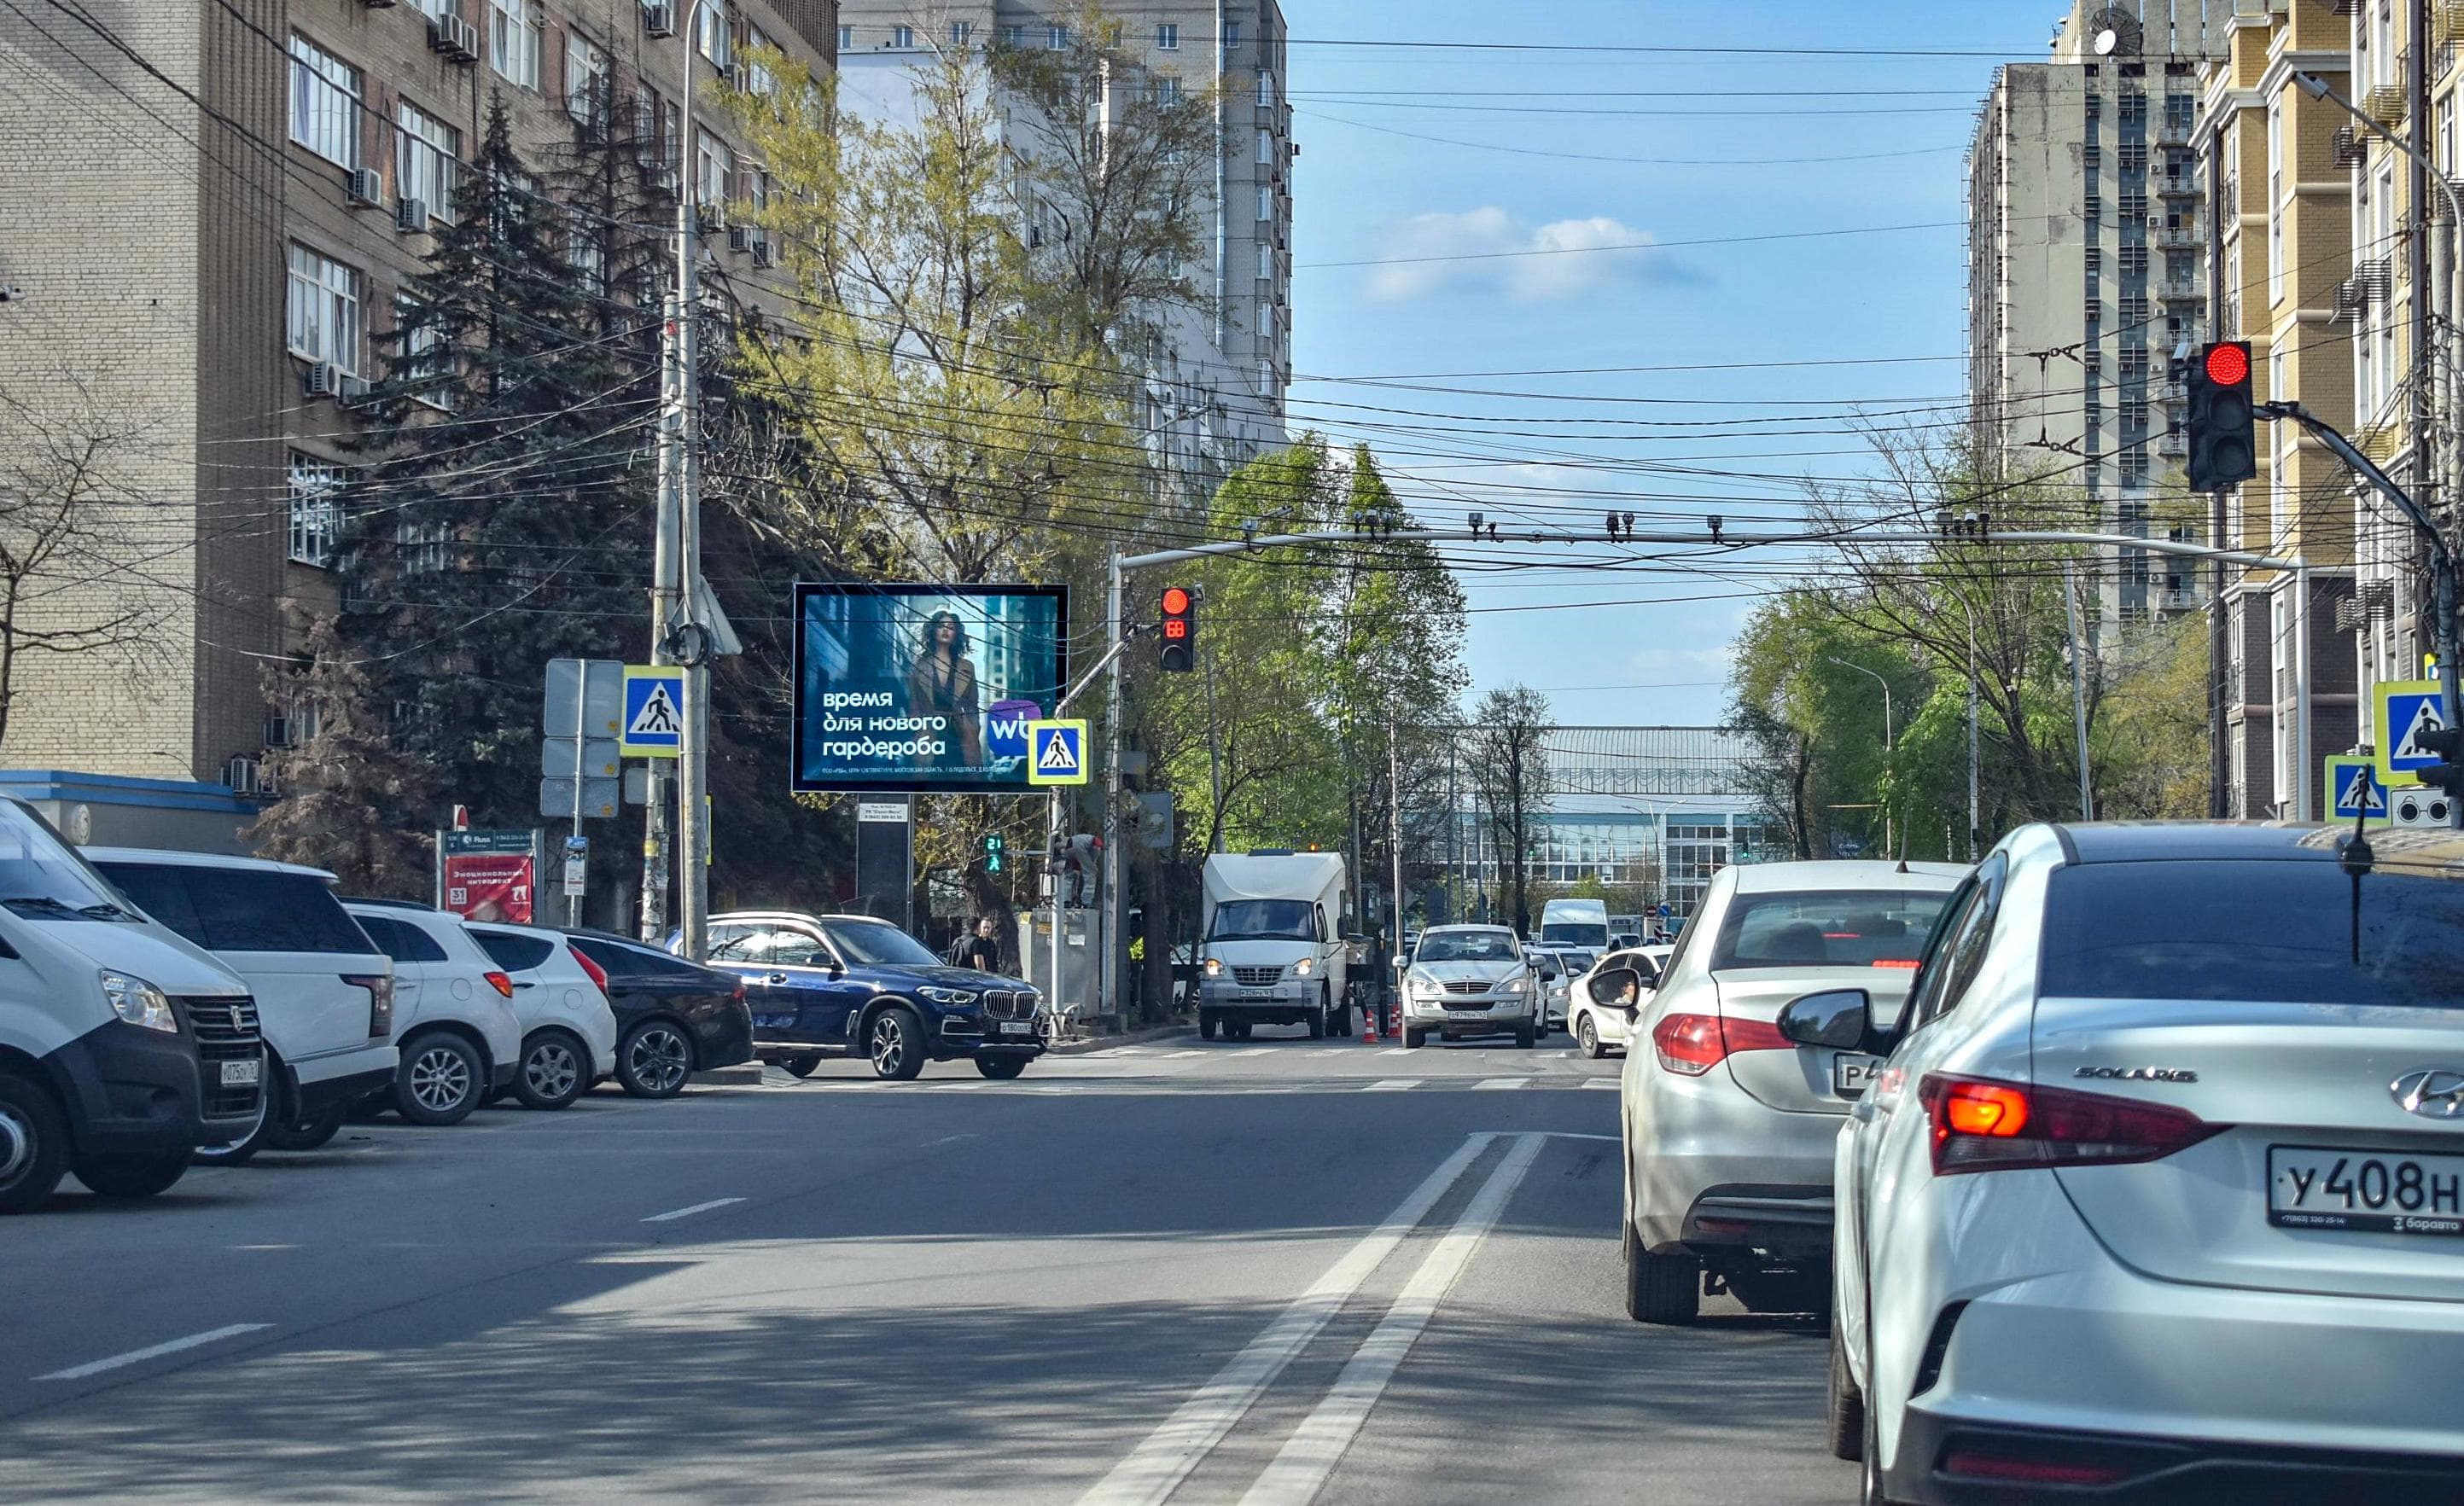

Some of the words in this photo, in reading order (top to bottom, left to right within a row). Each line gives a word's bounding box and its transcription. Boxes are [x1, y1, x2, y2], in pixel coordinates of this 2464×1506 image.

[823, 692, 893, 712] время
[823, 712, 863, 731] для
[869, 716, 947, 731] нового
[823, 736, 946, 761] гардероба
[987, 838, 1001, 850] 21
[451, 889, 464, 898] 31
[2073, 1066, 2199, 1083] SOLARIS
